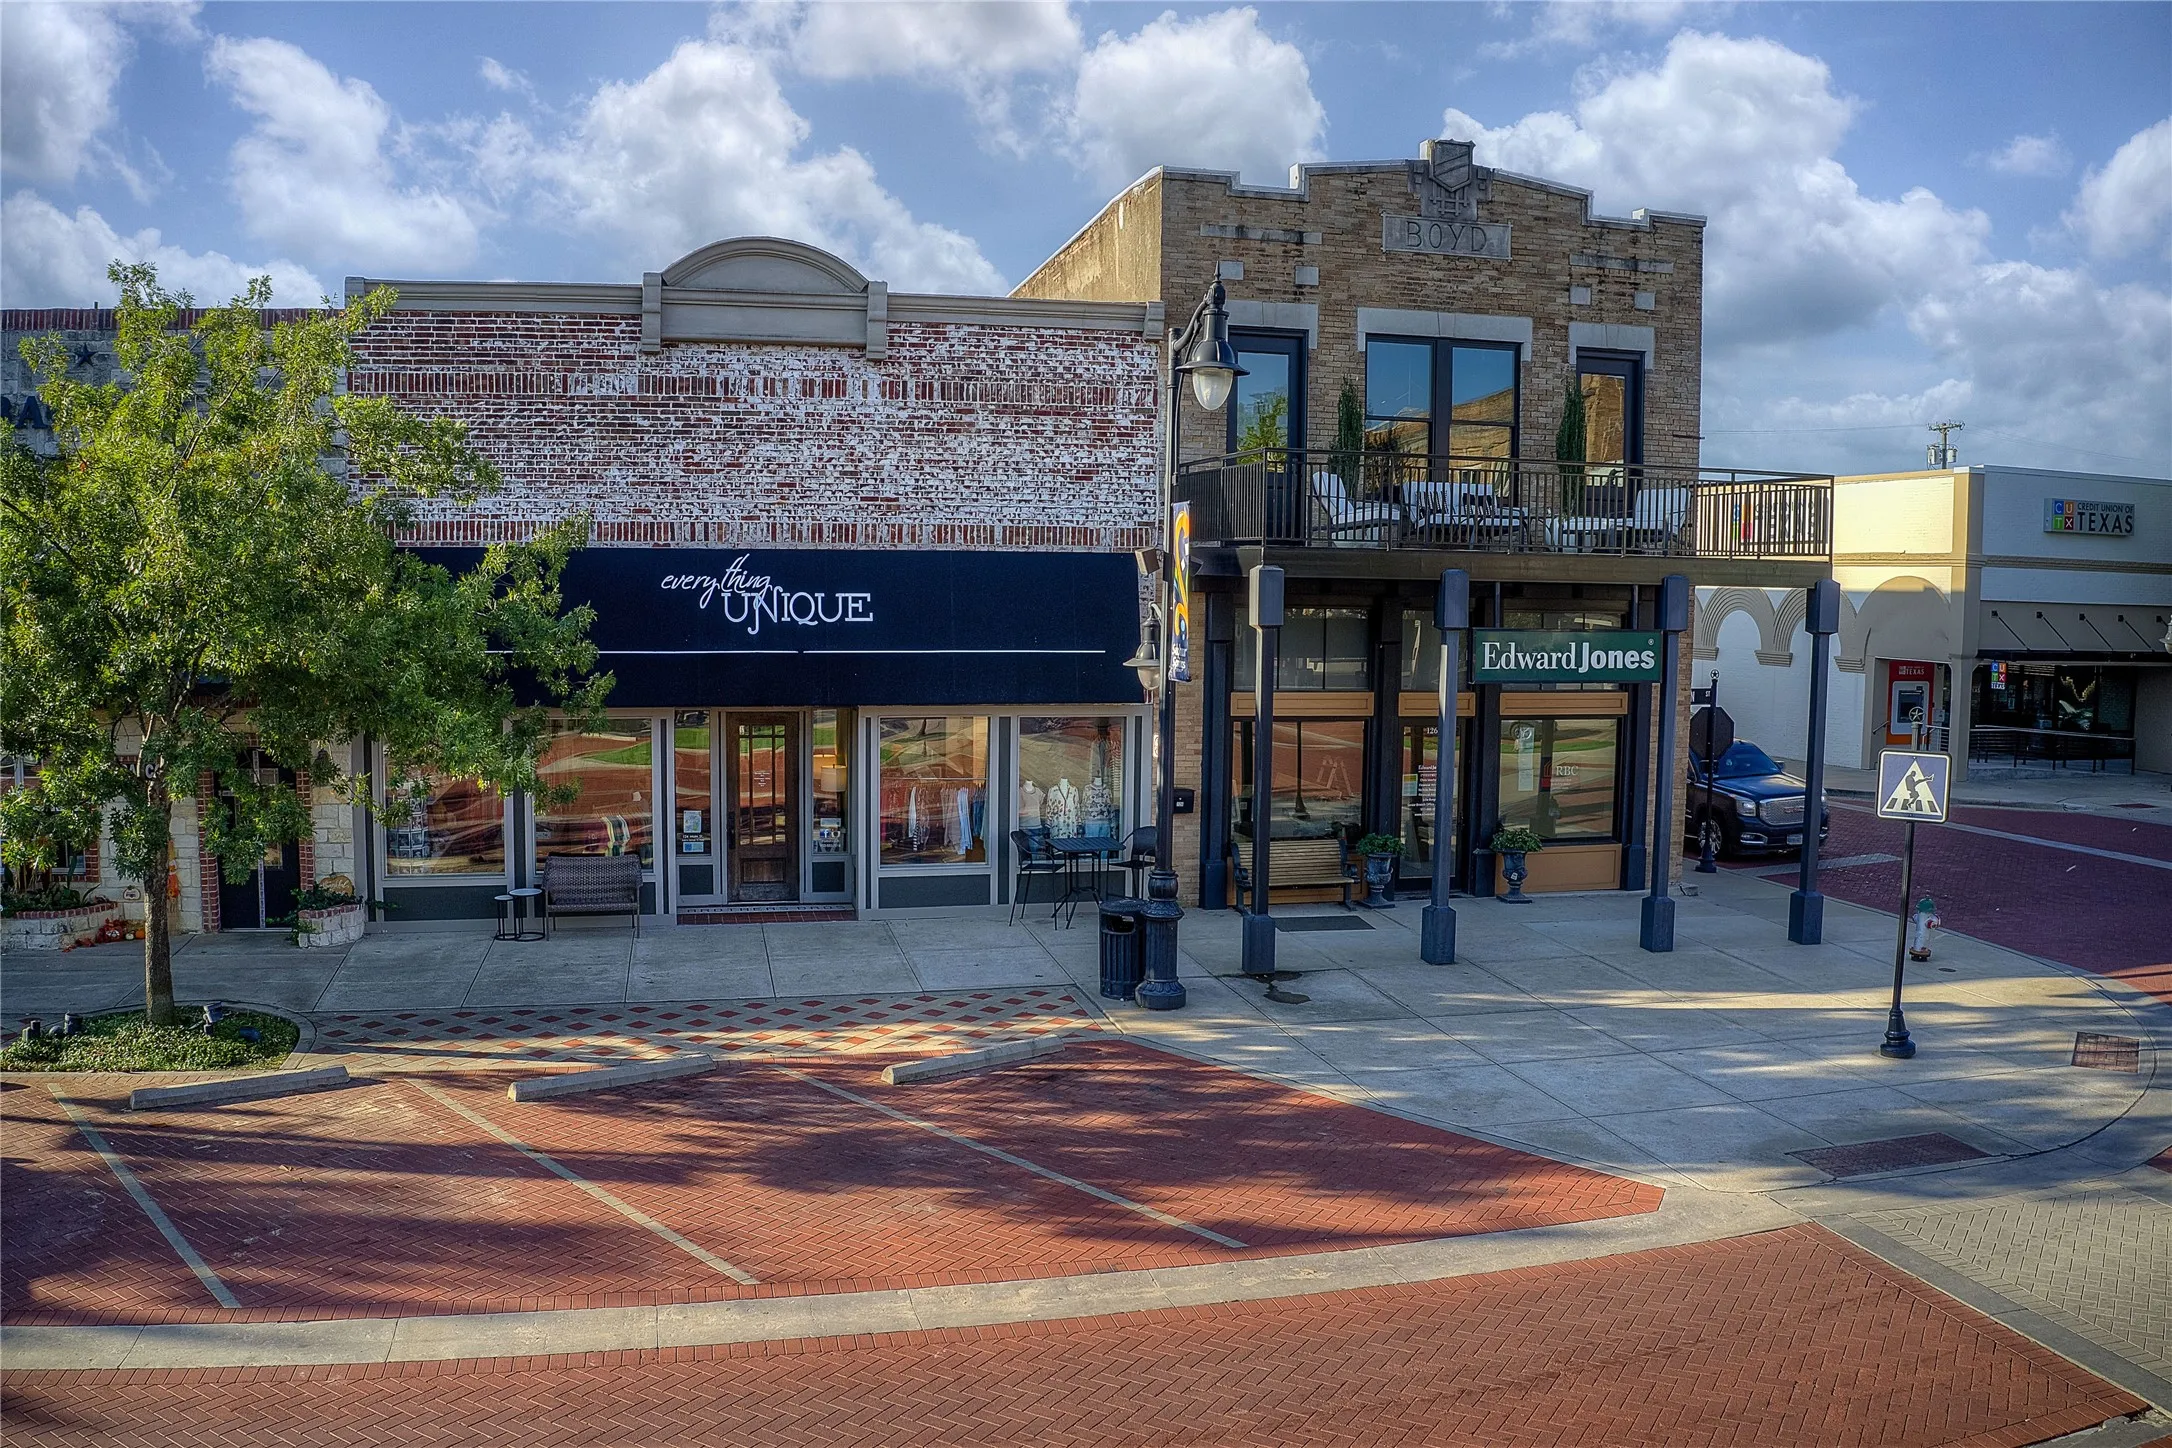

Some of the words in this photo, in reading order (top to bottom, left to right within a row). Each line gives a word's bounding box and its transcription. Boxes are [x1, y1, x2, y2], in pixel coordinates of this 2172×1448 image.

[1406, 220, 1487, 252] BOYD
[2077, 502, 2099, 511] CREDIT
[2101, 503, 2124, 513] UNION
[2124, 505, 2134, 514] OF
[2077, 511, 2133, 533] TEXAS
[661, 553, 773, 610] everything
[720, 585, 874, 635] UNIQUE
[1555, 765, 1579, 777] RBC
